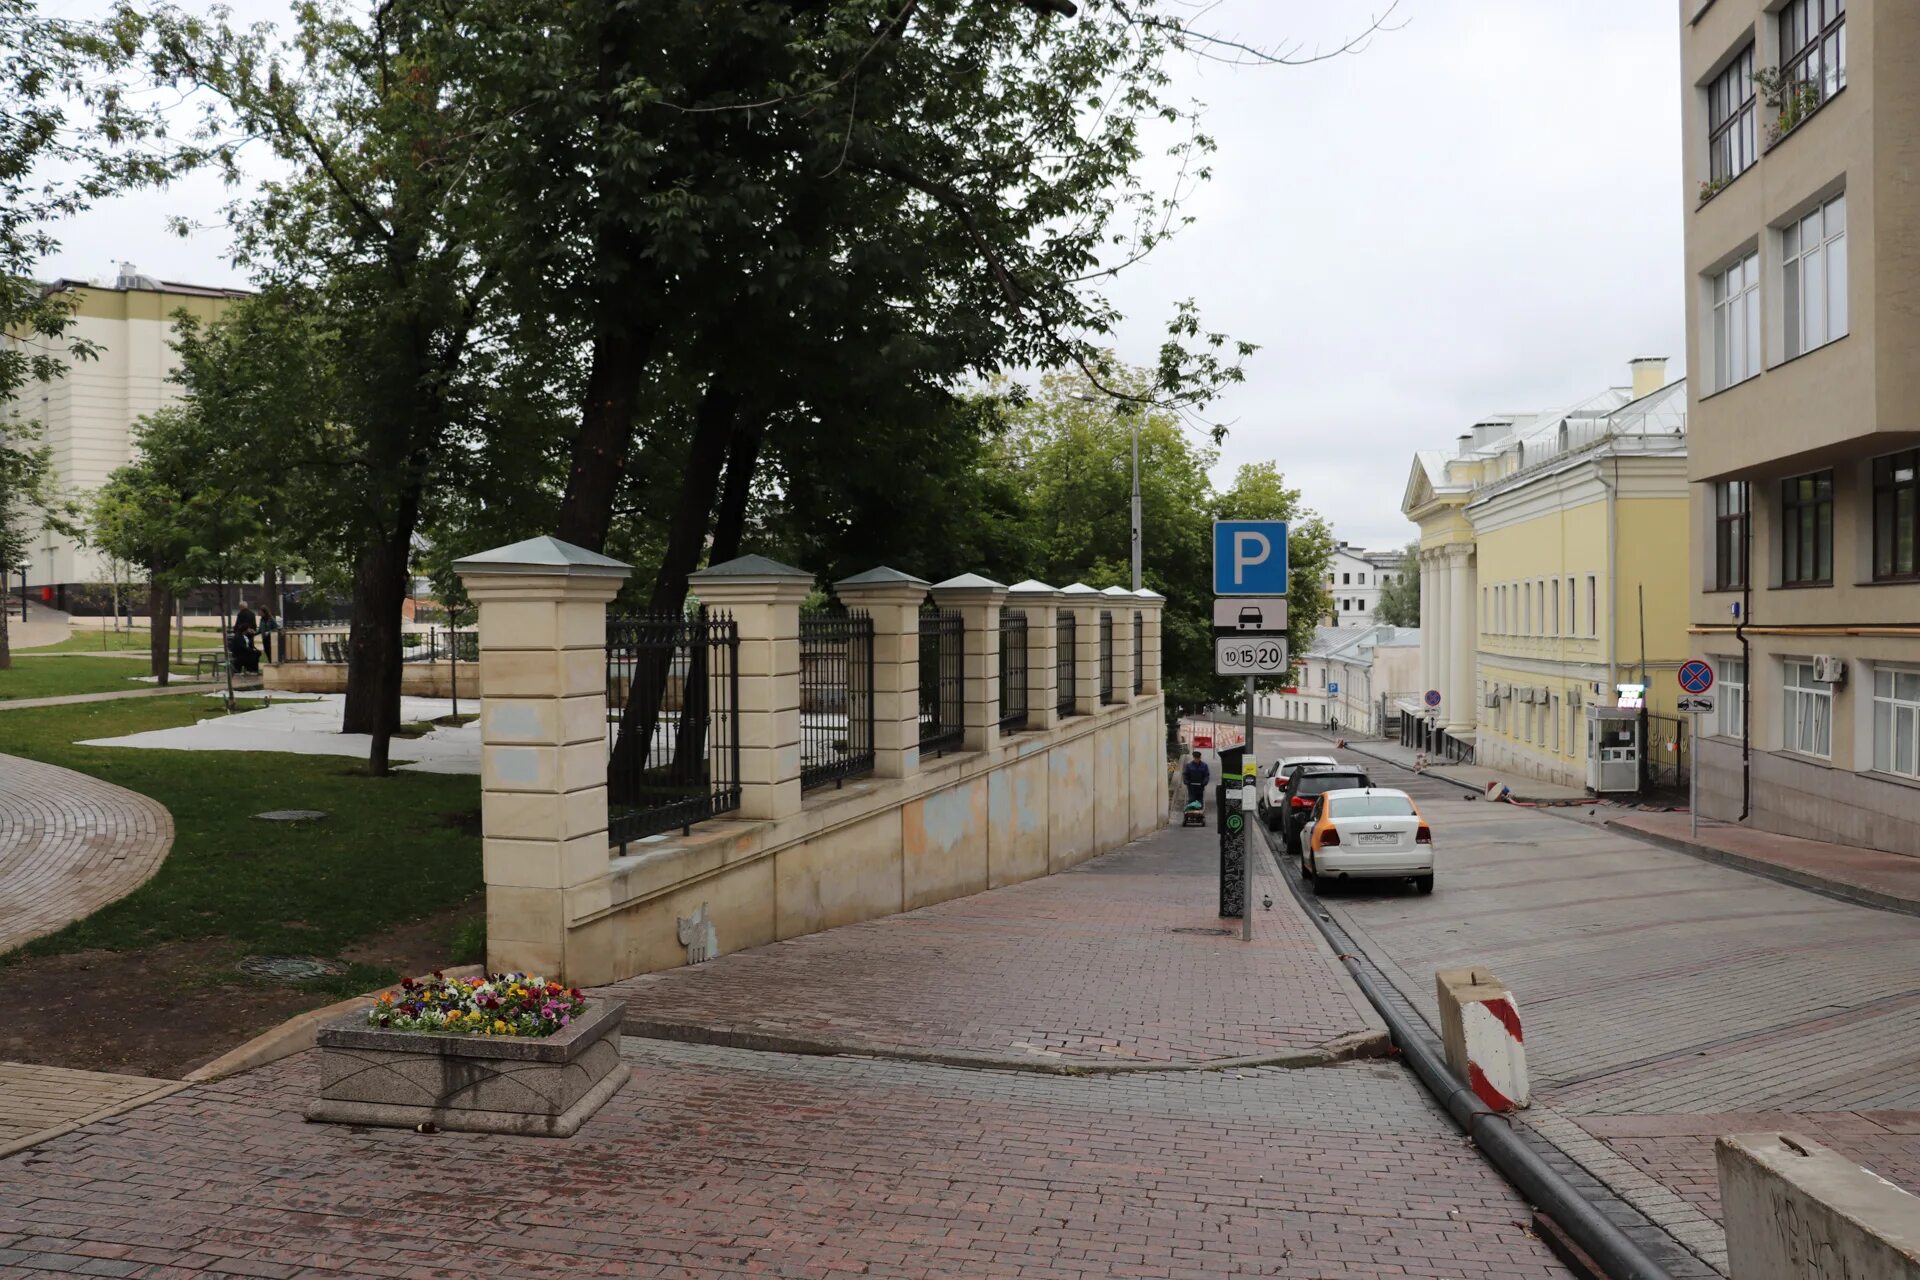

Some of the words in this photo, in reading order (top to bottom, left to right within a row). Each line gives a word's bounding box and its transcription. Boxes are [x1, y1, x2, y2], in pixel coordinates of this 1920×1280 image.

[1234, 531, 1271, 585] P
[1225, 651, 1236, 662] 10
[1240, 650, 1253, 663] 15
[1258, 648, 1279, 664] 20
[1231, 819, 1239, 827] P
